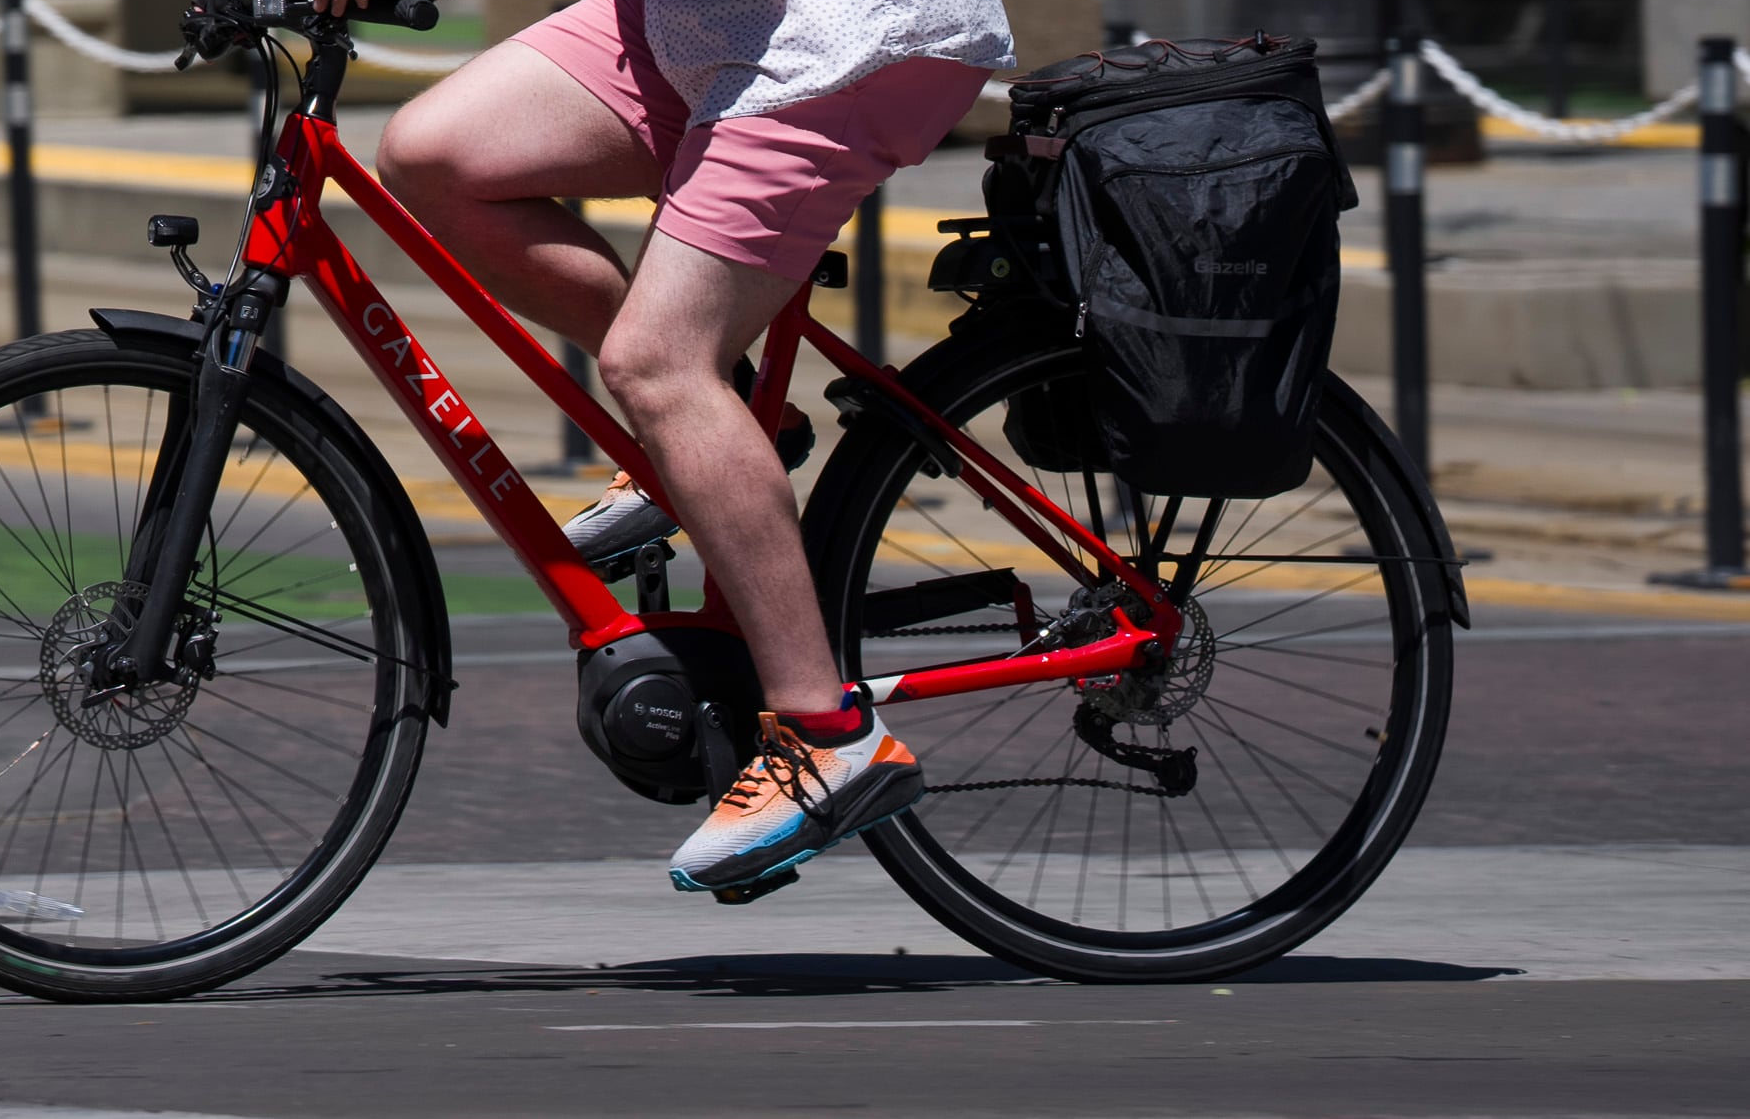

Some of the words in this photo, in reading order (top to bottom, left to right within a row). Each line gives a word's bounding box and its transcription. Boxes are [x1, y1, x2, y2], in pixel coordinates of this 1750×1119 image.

[1194, 257, 1267, 274] Gazelle
[362, 302, 520, 502] GAZELLE
[649, 706, 683, 720] BOSCH
[665, 732, 680, 741] Plus
